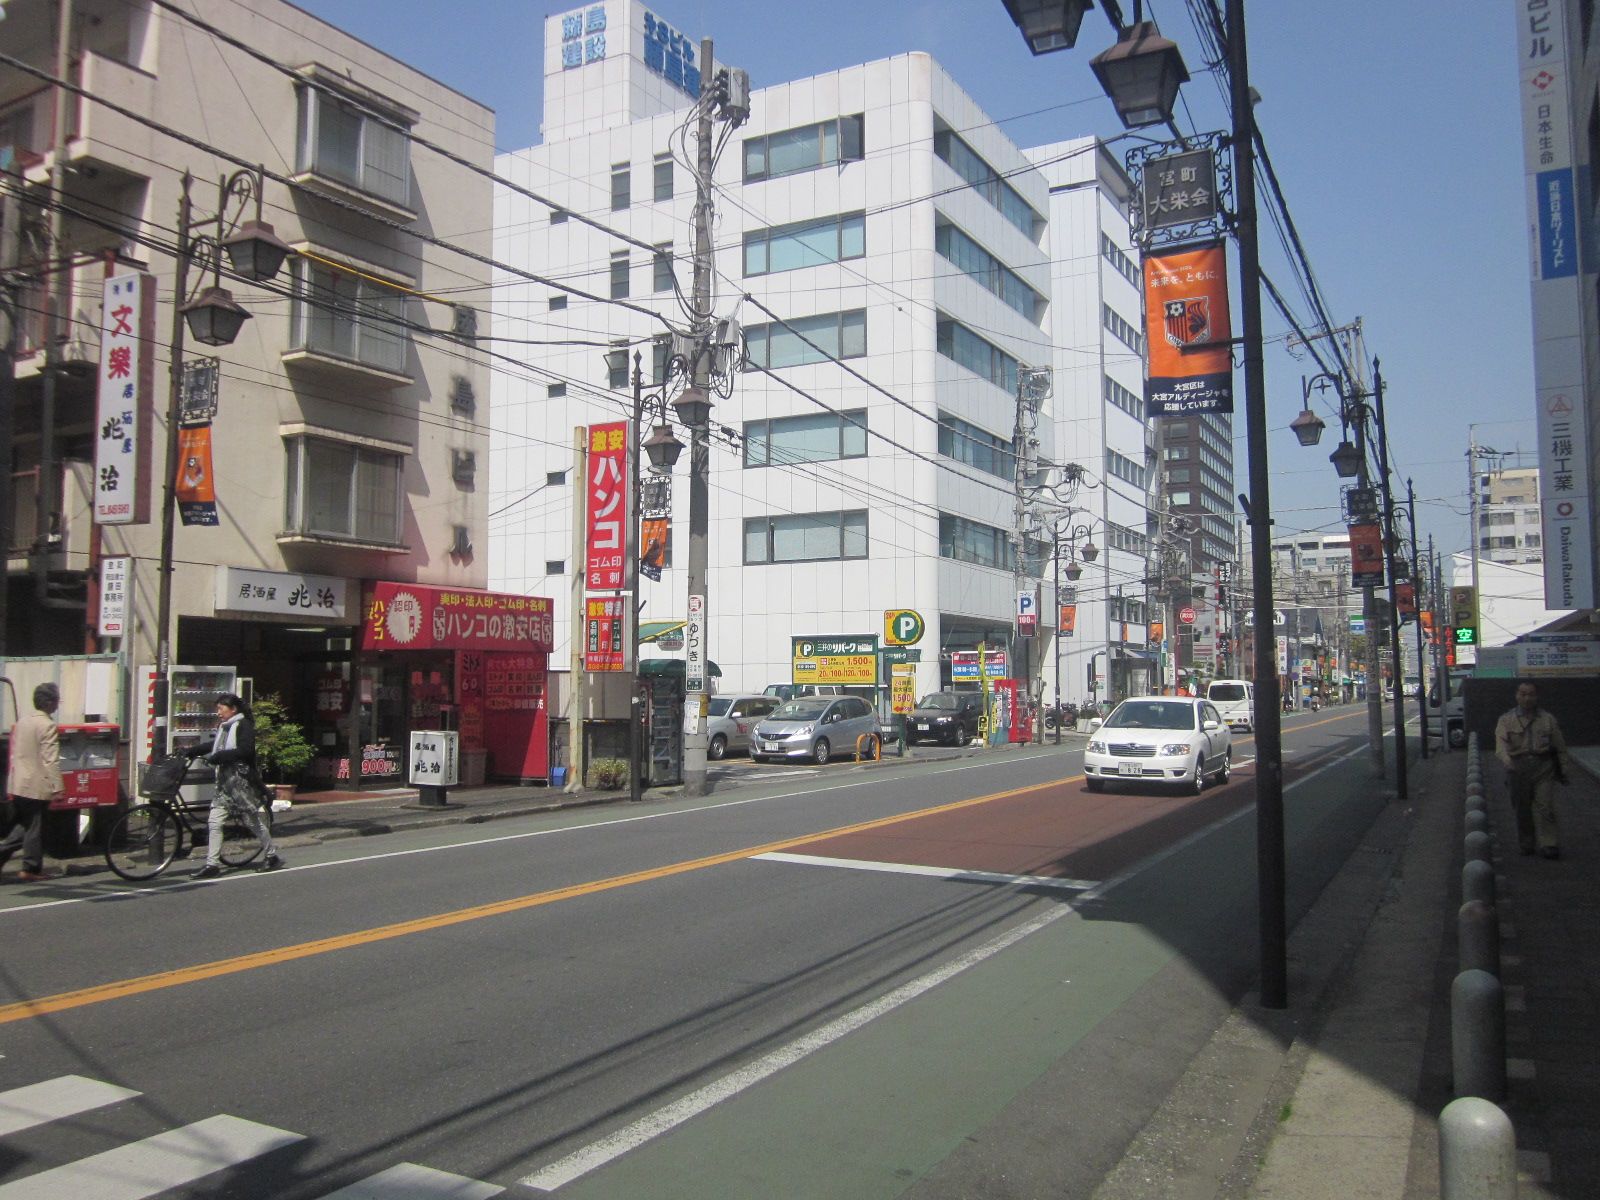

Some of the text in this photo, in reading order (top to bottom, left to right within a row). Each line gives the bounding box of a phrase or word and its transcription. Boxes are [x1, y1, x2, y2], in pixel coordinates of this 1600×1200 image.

[1538, 104, 1554, 165] 日本生命
[1160, 166, 1197, 187] 宮町
[1150, 187, 1210, 215] 大栄会
[591, 429, 624, 452] 激安
[1552, 422, 1574, 491] 三機工業
[593, 455, 622, 549] ハンコ
[590, 555, 622, 569] ゴム印
[590, 570, 620, 584] 名刺
[239, 584, 277, 601] 居酒屋
[1020, 597, 1032, 614] P
[373, 600, 385, 640] ハンコ
[448, 612, 542, 642] ハンコの激安店
[900, 617, 915, 639] P
[1455, 611, 1471, 627] P
[1456, 627, 1473, 643] 空
